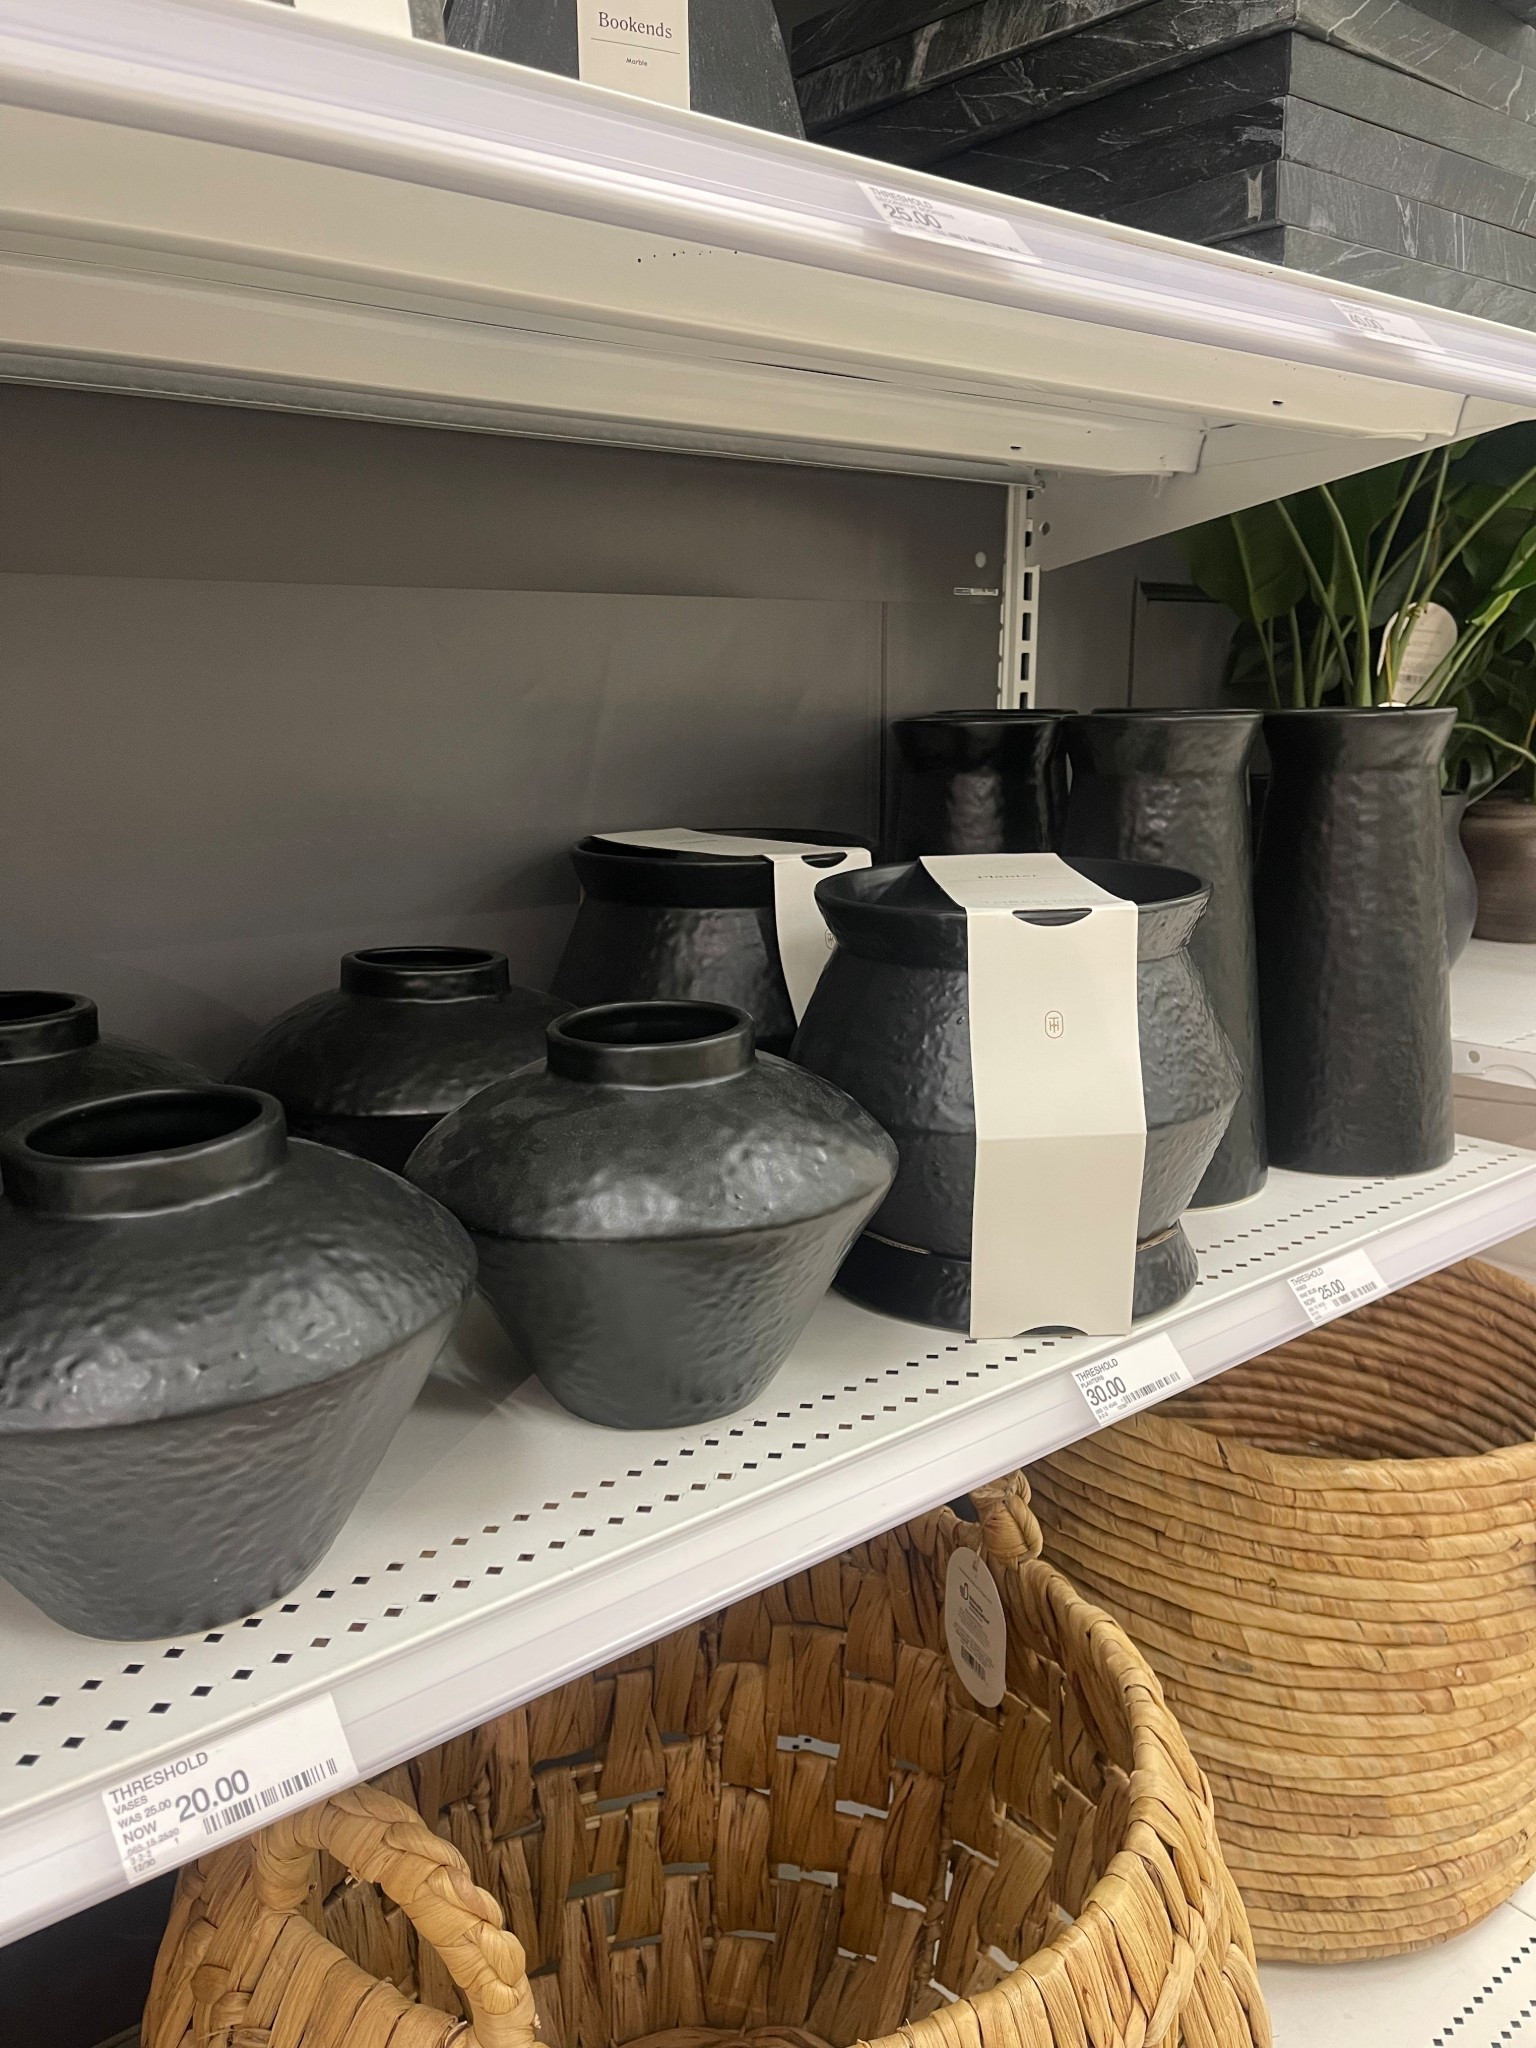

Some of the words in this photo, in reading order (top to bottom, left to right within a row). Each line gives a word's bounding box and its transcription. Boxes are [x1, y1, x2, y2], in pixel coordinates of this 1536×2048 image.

[598, 11, 673, 39] Bookends
[626, 57, 648, 67] Marble
[869, 186, 933, 210] THRESHOLD
[883, 203, 942, 229] 25.00
[1290, 1267, 1324, 1287] THRESHOLD
[1318, 1279, 1346, 1300] 25.00
[1075, 1358, 1119, 1382] THRESHOLD
[1080, 1374, 1105, 1389] PLANTERS
[1086, 1376, 1127, 1407] 30.00
[109, 1752, 209, 1805] THRESHOLD
[113, 1795, 148, 1815] VASES
[117, 1813, 142, 1829] WAS
[144, 1799, 171, 1818] 25.00
[122, 1820, 157, 1845] NOW
[175, 1769, 250, 1823] 20.00
